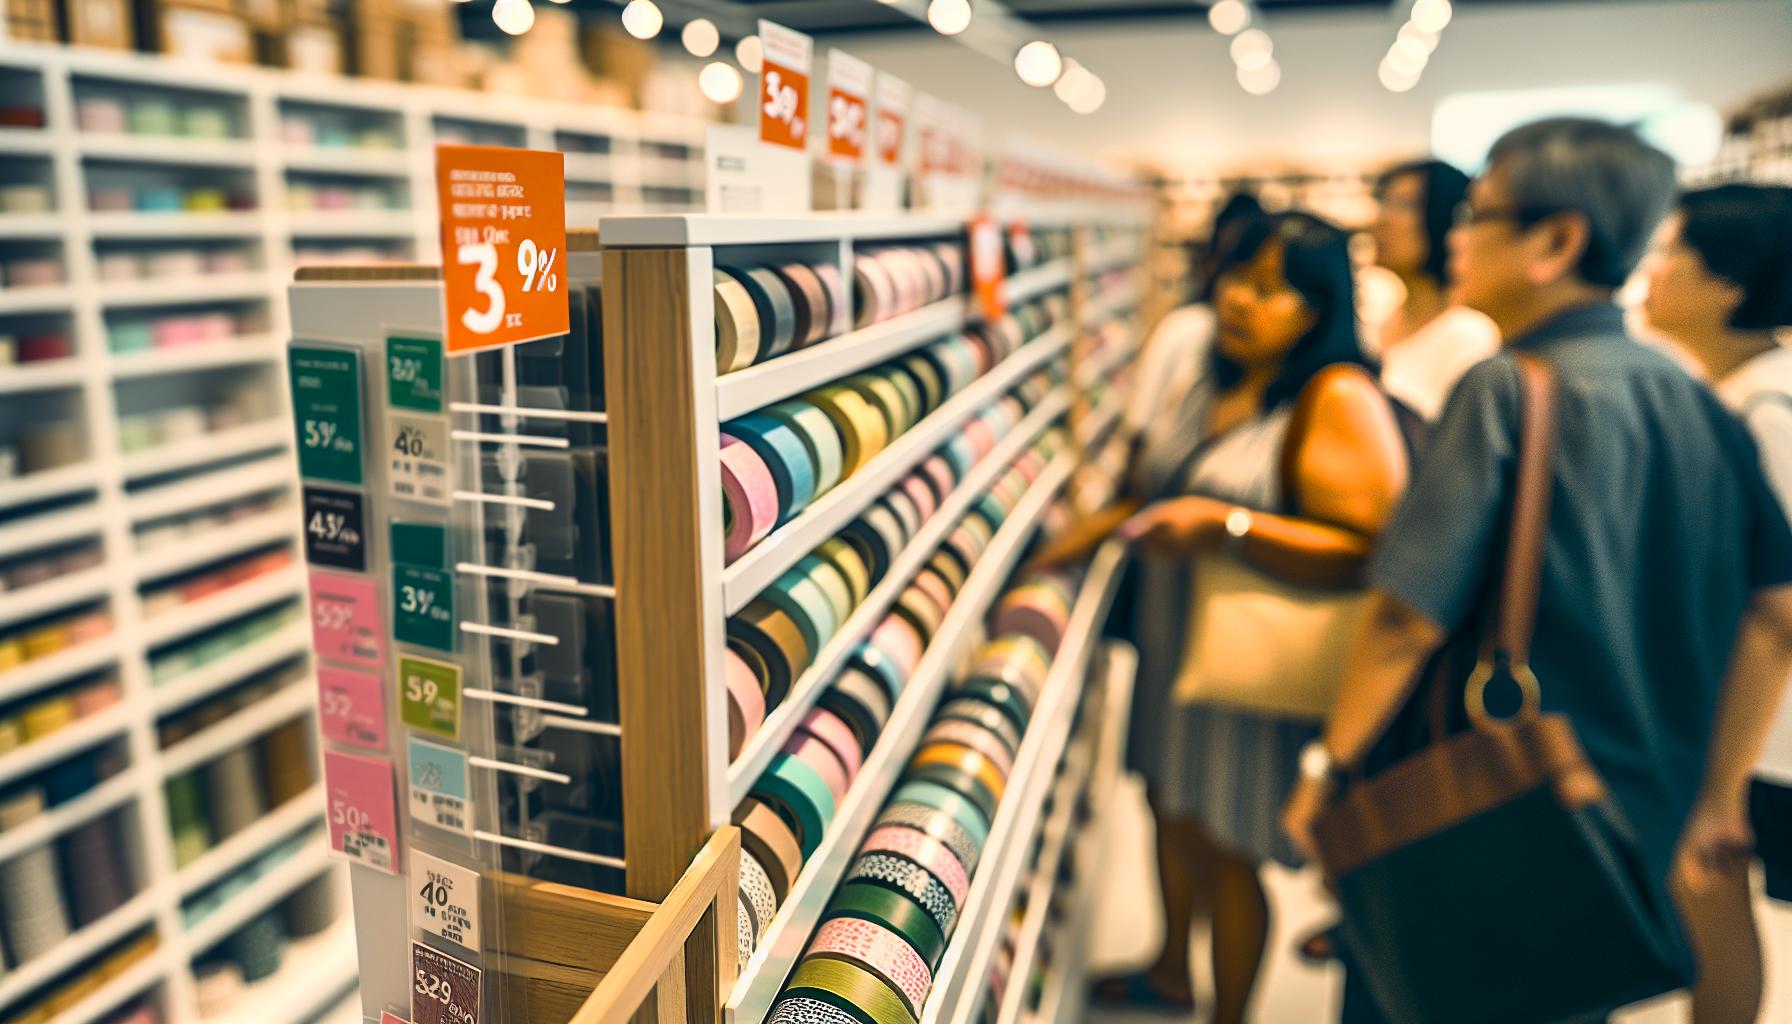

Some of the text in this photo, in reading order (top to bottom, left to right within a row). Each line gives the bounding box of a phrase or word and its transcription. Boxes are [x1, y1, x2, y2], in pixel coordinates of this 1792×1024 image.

[457, 238, 557, 334] 3 9%
[406, 674, 439, 705] 59
[419, 881, 449, 907] 40
